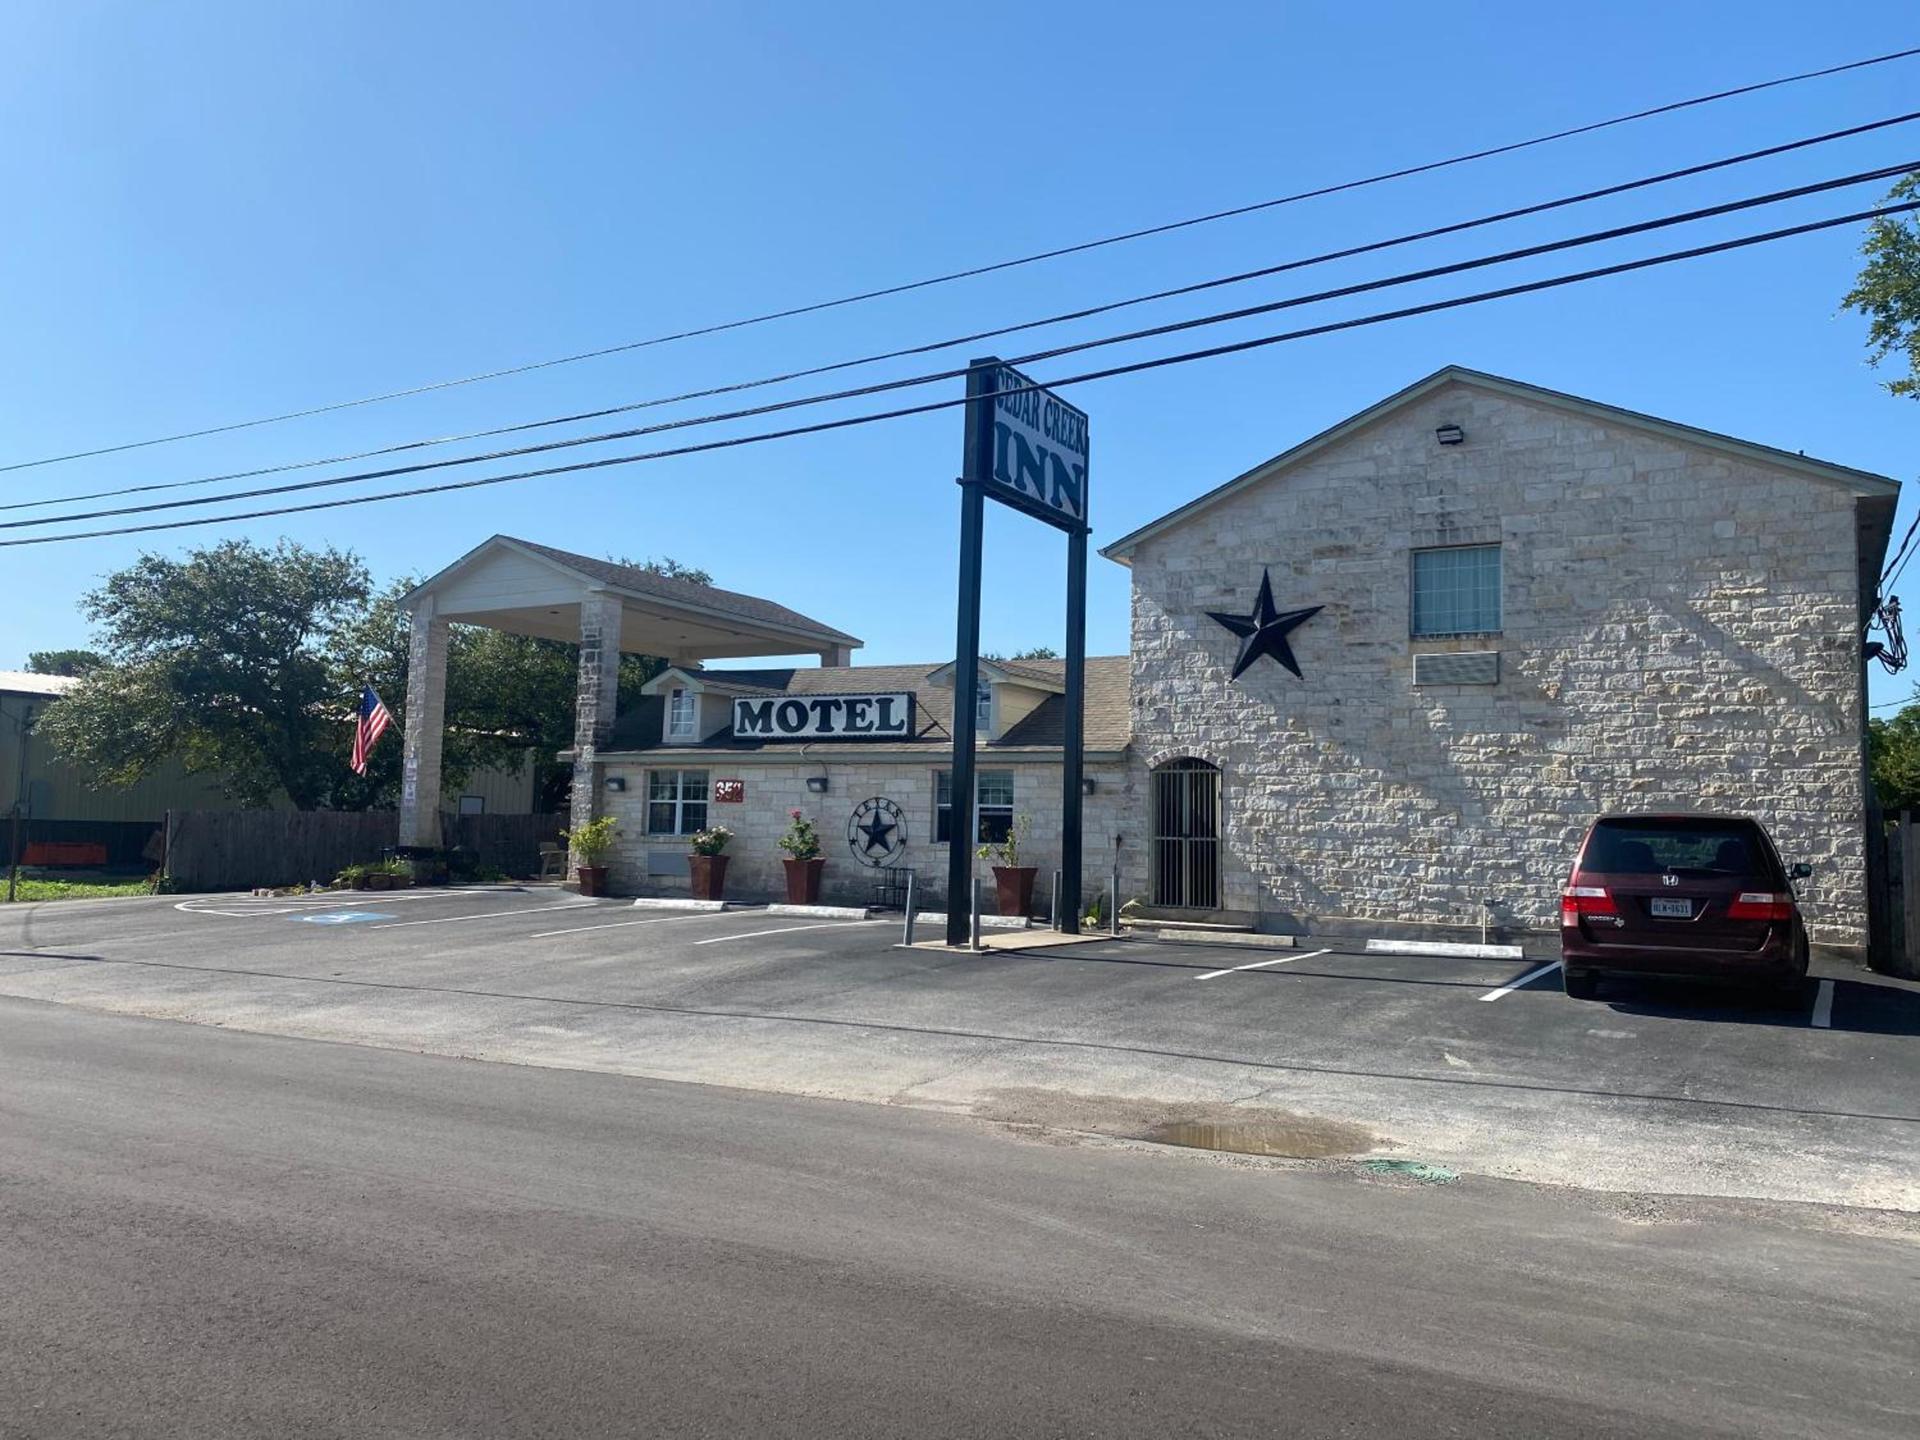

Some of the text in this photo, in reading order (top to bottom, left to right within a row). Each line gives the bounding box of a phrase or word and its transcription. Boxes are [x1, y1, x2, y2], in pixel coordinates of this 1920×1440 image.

[995, 367, 1086, 456] CEDAR CREEK
[995, 421, 1084, 517] INN
[736, 697, 905, 734] MOTEL
[851, 797, 903, 819] TEXAS
